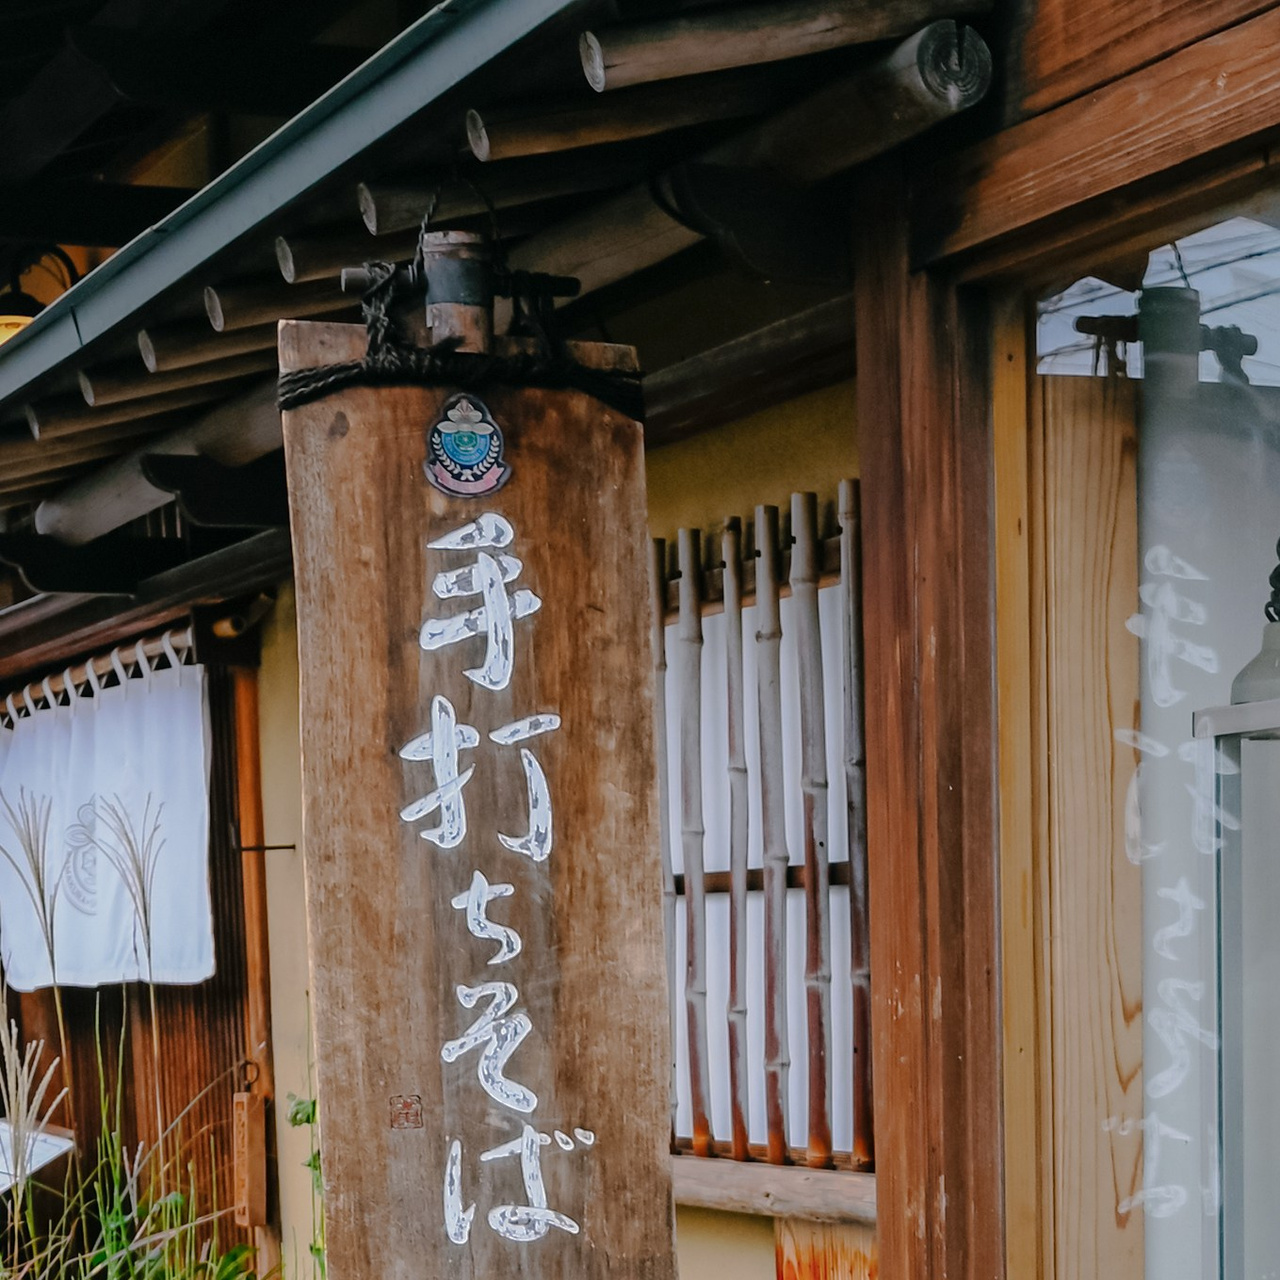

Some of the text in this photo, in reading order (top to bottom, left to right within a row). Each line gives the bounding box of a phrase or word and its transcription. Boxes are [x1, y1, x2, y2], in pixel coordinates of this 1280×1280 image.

[400, 511, 595, 1246] 手打ちそば
